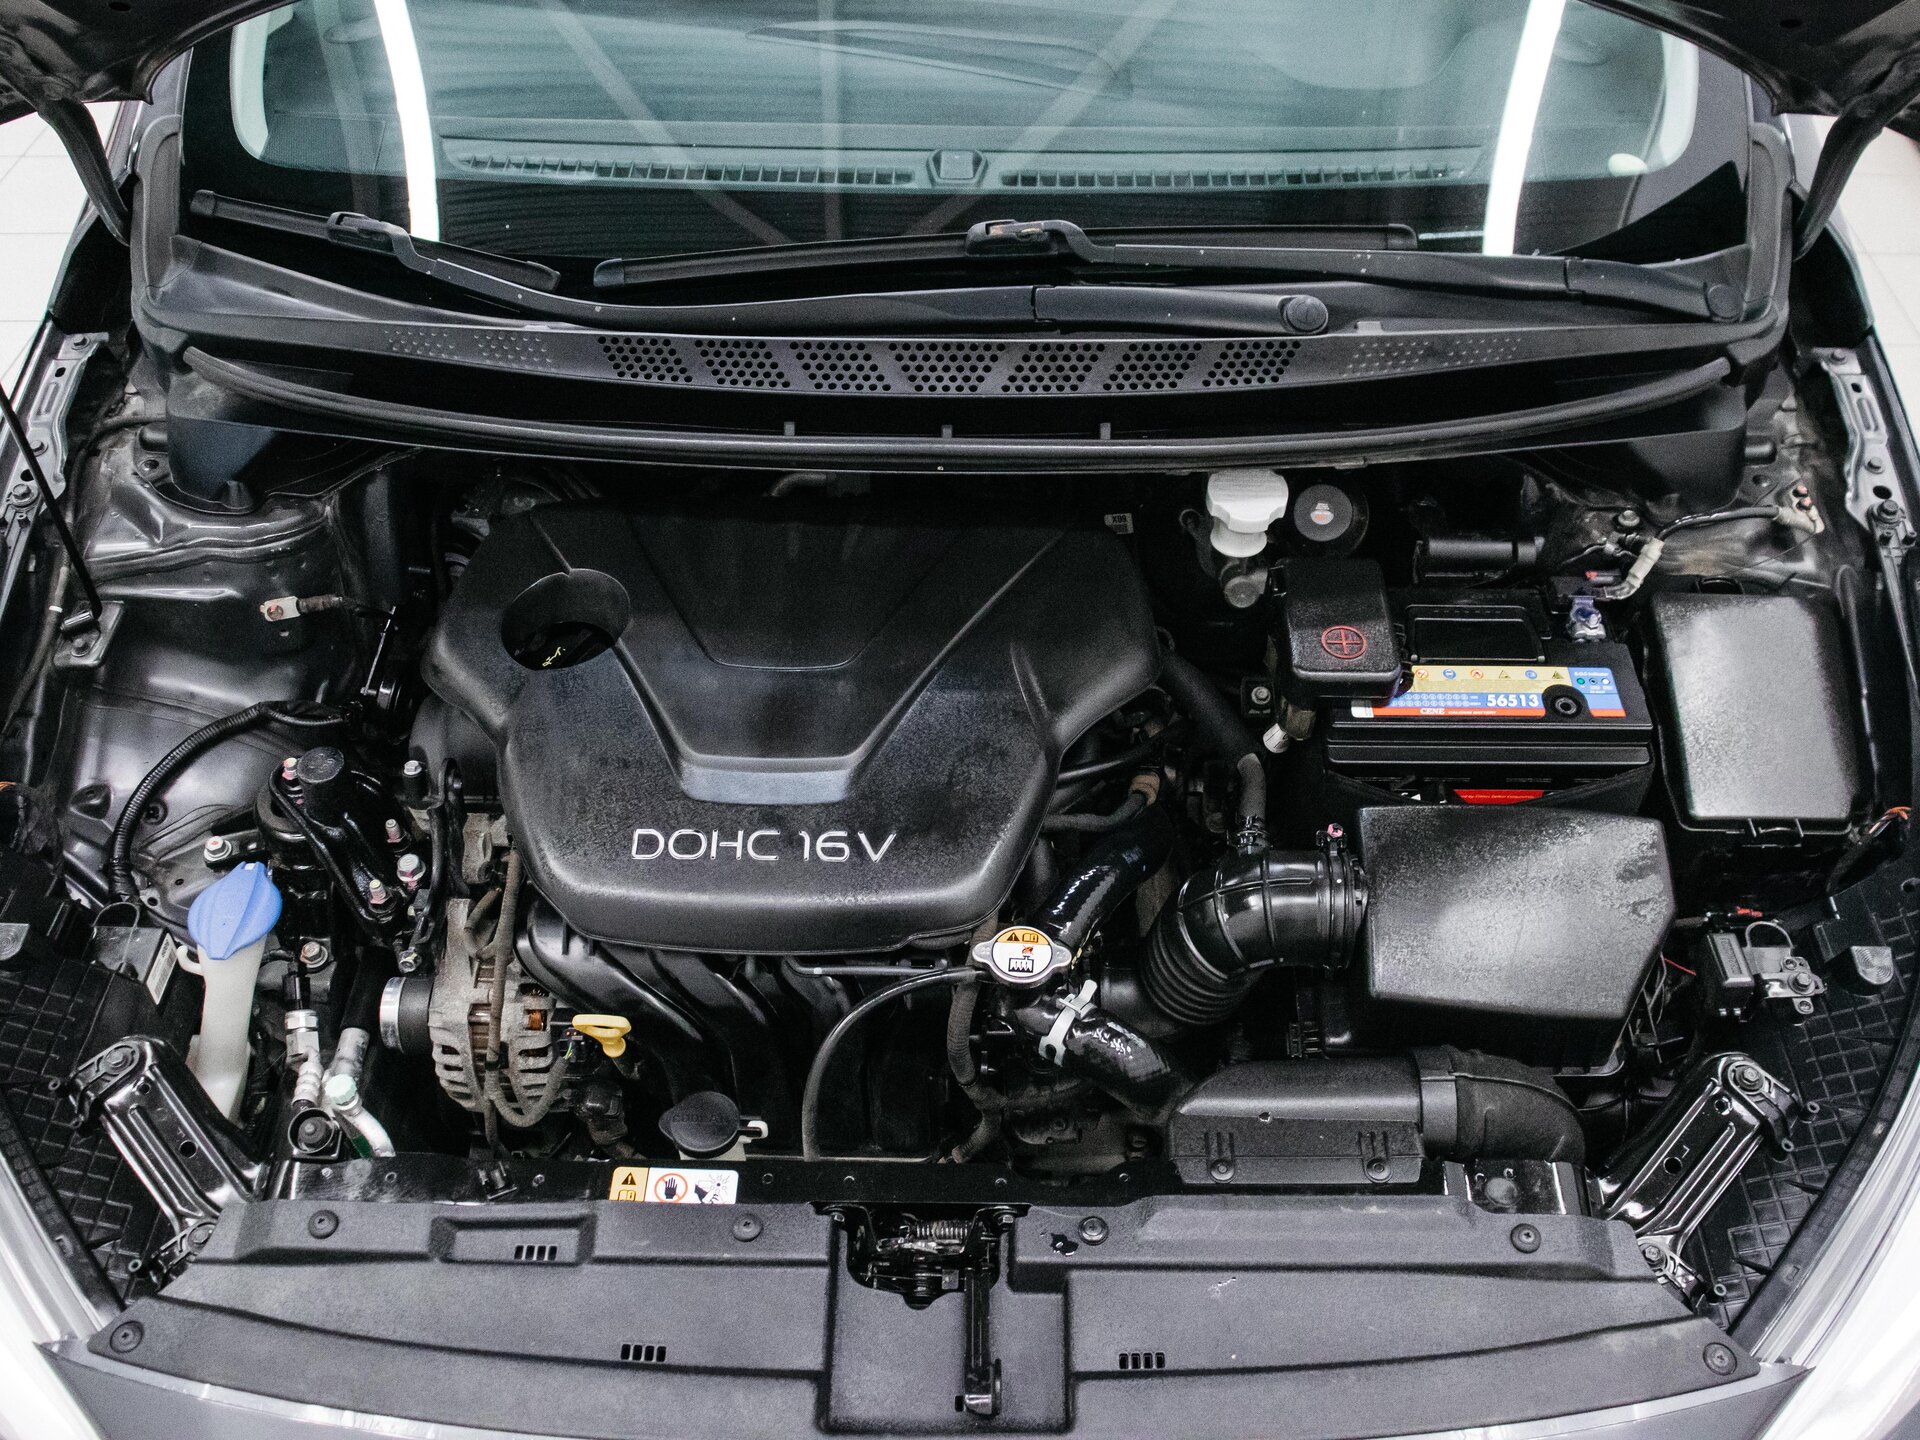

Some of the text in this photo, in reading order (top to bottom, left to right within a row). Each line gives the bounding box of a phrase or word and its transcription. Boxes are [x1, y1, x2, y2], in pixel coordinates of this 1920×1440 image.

[1487, 694, 1539, 707] 56513
[631, 828, 897, 862] DOHC 16V
